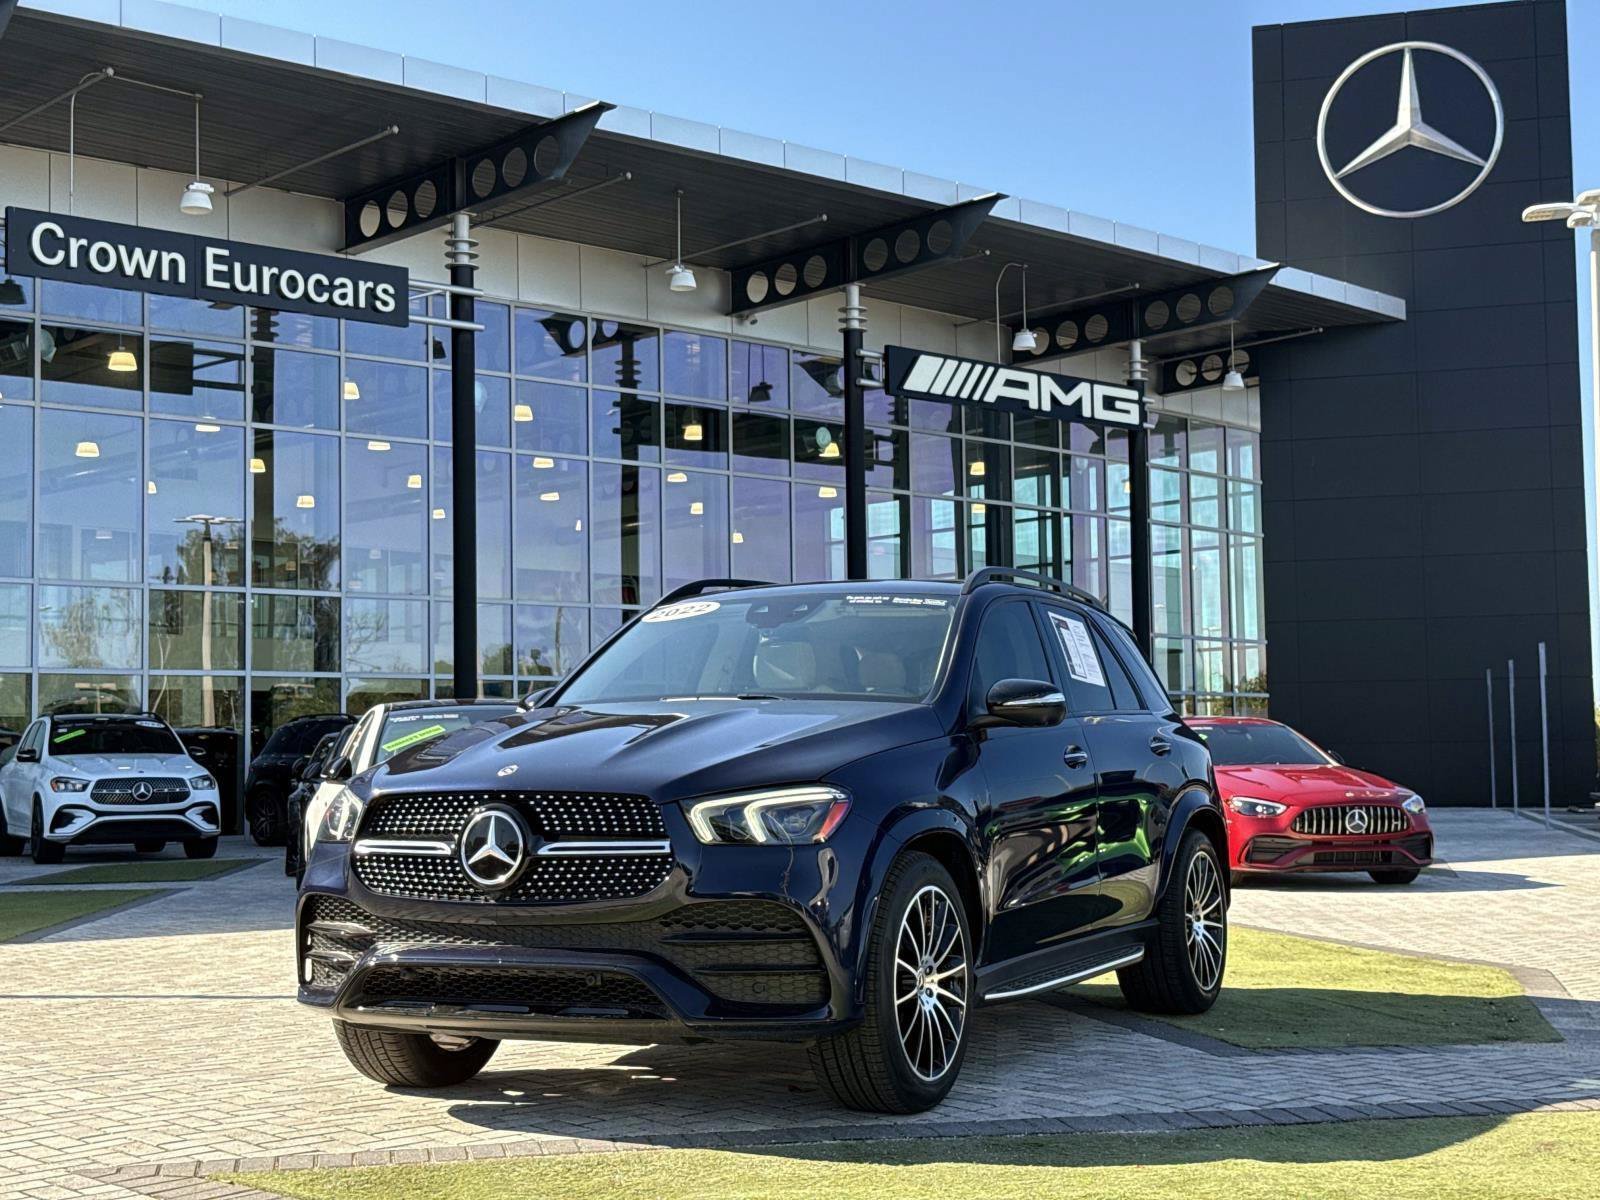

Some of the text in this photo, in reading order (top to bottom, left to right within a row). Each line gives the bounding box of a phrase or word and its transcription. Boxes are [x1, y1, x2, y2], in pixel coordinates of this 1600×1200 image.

[31, 222, 396, 313] Crown Eurocars
[984, 368, 1139, 425] AMG
[649, 603, 711, 619] 2022
